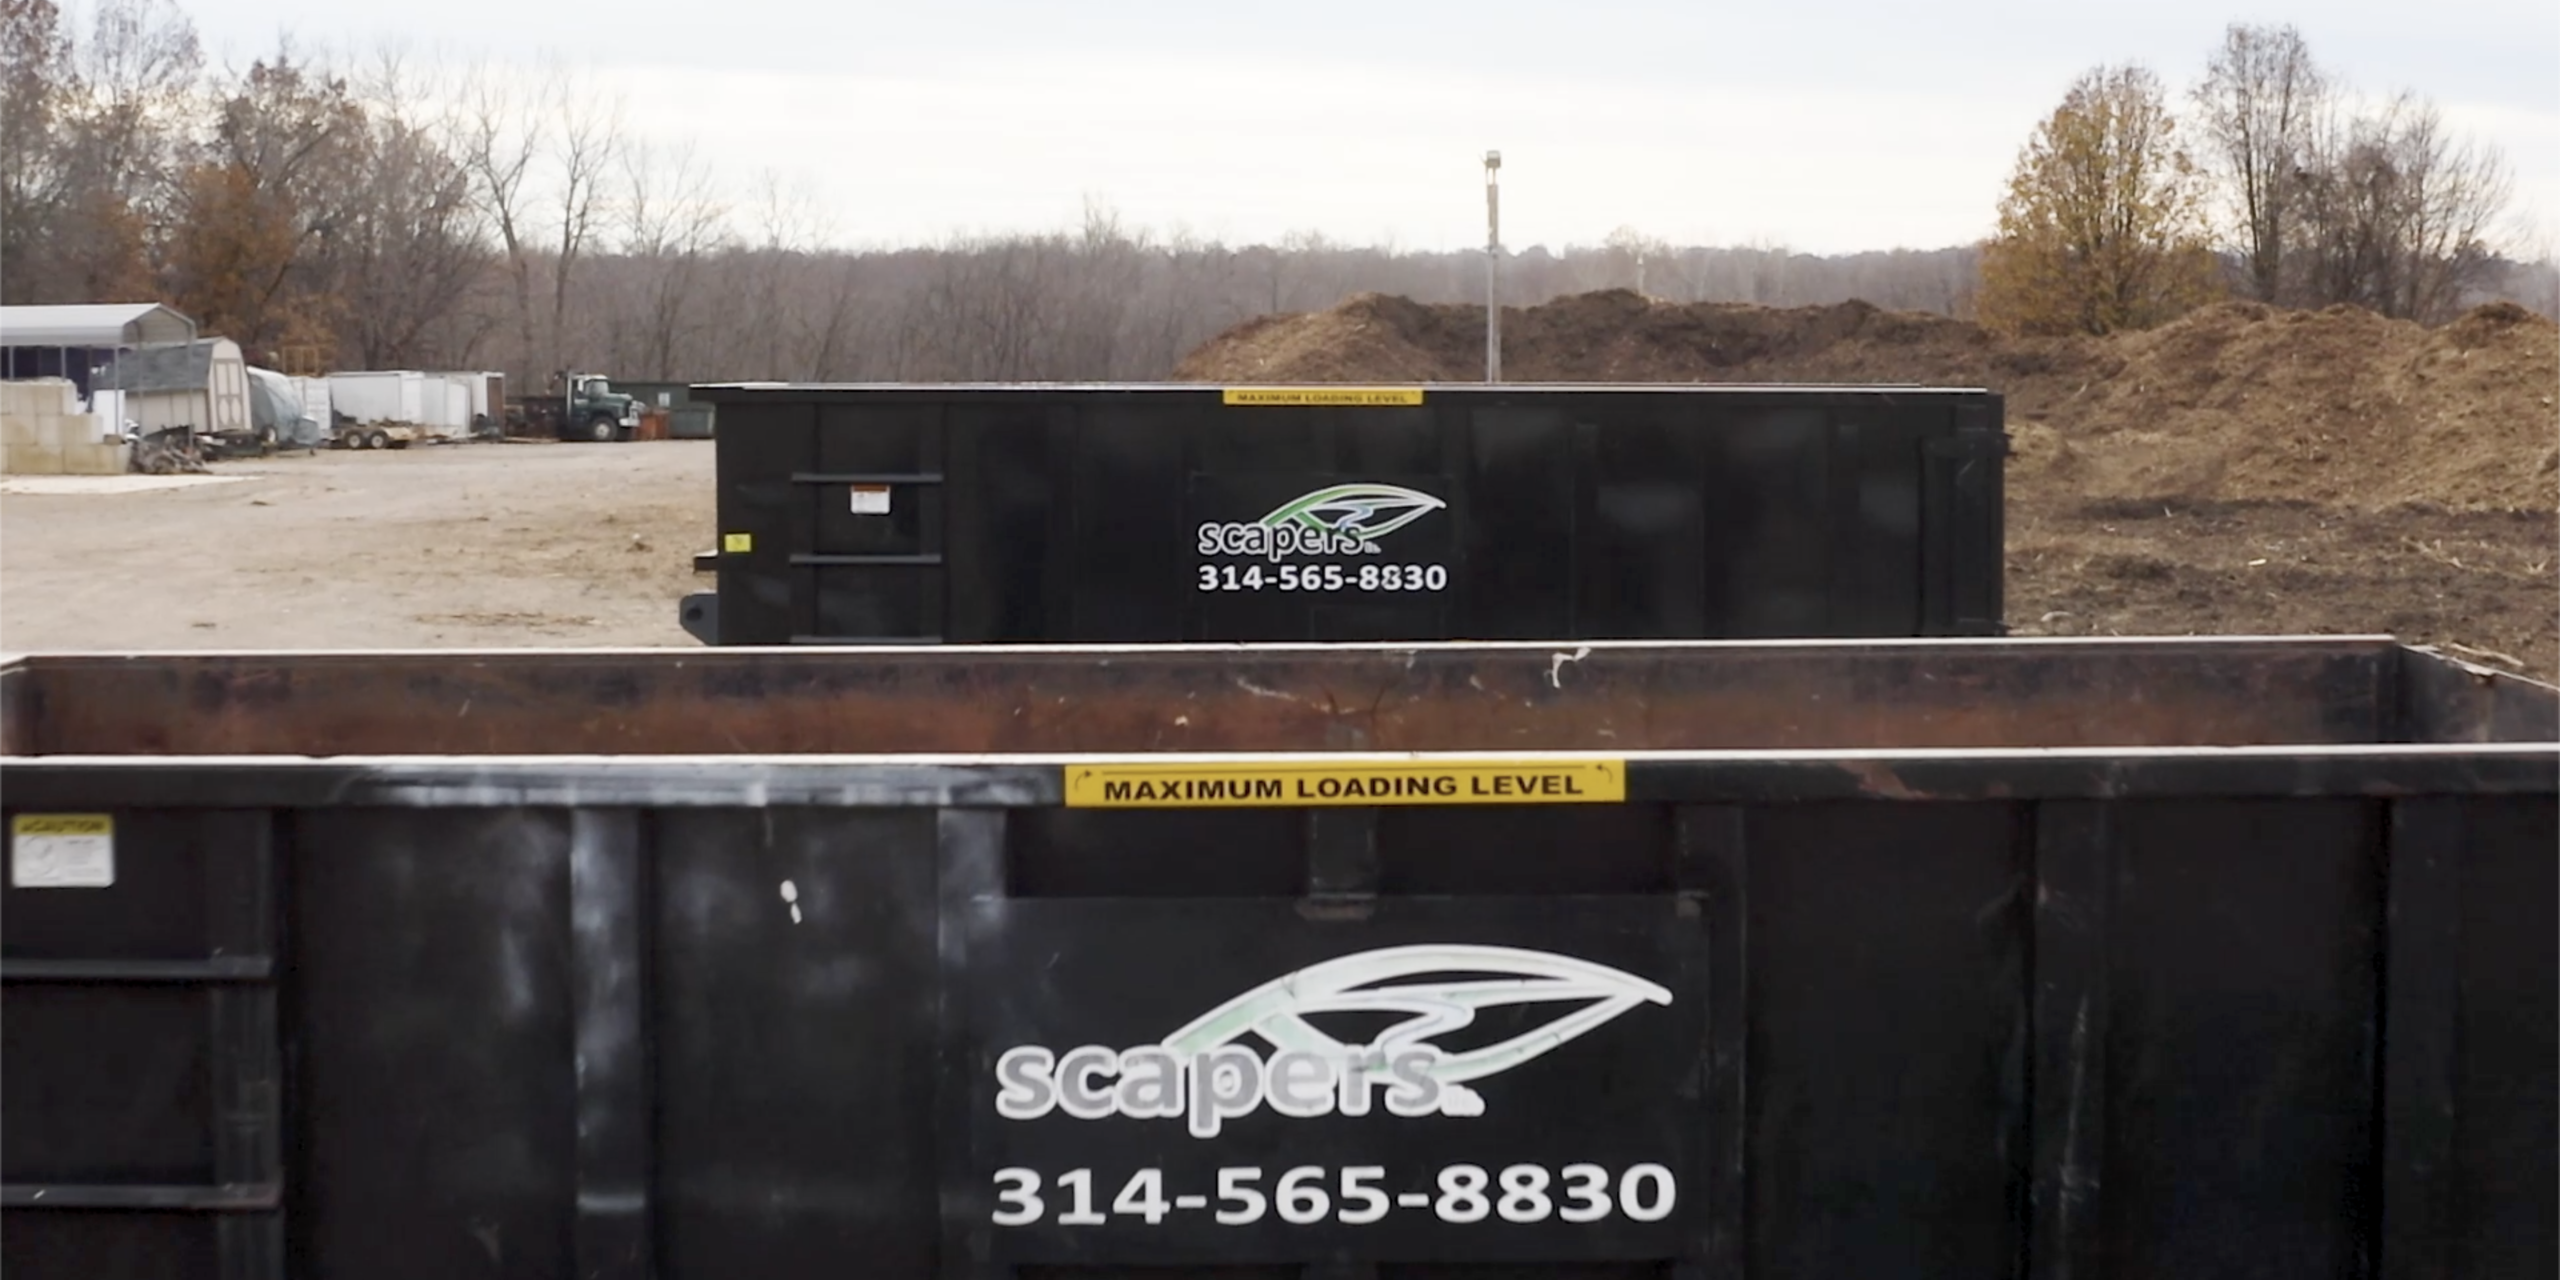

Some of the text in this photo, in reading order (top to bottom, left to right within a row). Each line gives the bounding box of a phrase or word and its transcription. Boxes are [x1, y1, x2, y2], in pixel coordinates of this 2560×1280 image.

[1237, 393, 1408, 403] MAXIMUM LOADING LEVEL
[1198, 522, 1364, 563] scapers
[1198, 564, 1447, 591] 314-565-8830
[1104, 774, 1584, 801] MAXIMUM LOADING LEVEL
[996, 1045, 1444, 1137] scapers
[992, 1163, 1677, 1225] 314-565-8830
